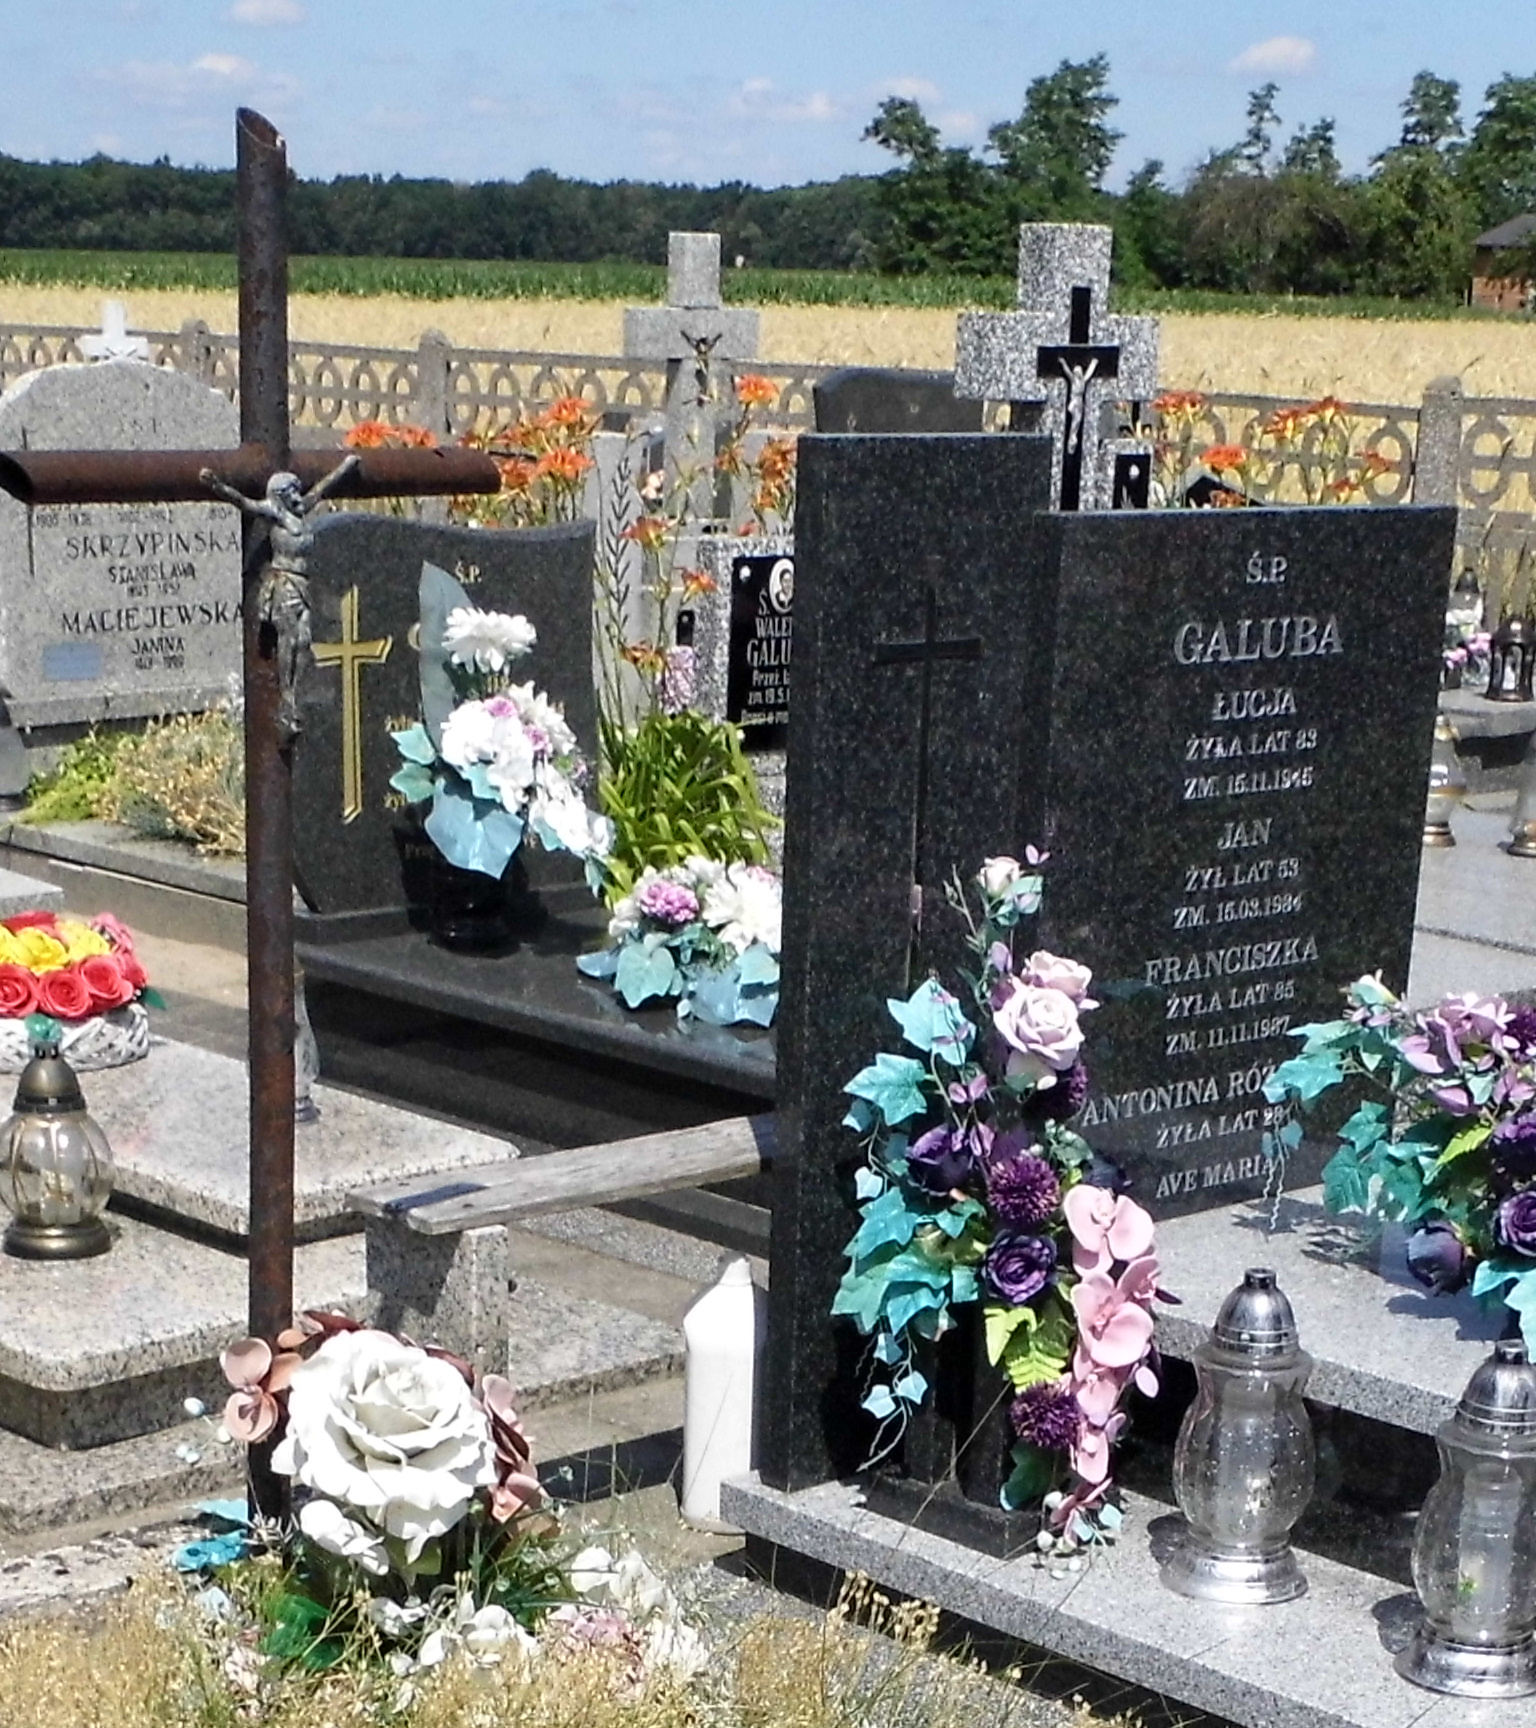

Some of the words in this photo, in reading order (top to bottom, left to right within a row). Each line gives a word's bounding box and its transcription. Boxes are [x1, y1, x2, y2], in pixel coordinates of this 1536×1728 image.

[1173, 614, 1345, 665] GALUBA
[1213, 687, 1298, 721] ŁUCJA
[1185, 733, 1244, 761] ŻYŁA
[1249, 729, 1292, 755] LAT
[1183, 776, 1221, 800] ZM.
[1216, 818, 1274, 851] JAN
[1185, 864, 1227, 892] ŻYŁ
[1232, 859, 1275, 887] LAT
[1172, 904, 1211, 930] ZM.
[1144, 935, 1321, 988] FRANCISZKA
[1165, 990, 1223, 1020] ŻYŁA
[1228, 983, 1271, 1010] LAT
[1165, 1032, 1203, 1056] ZM.
[1080, 1077, 1220, 1128] ANTONINA
[1156, 1122, 1212, 1150] ŻYŁA
[1218, 1109, 1259, 1136] LAT
[1155, 1169, 1198, 1199] AVE
[1202, 1154, 1272, 1189] MARIA
